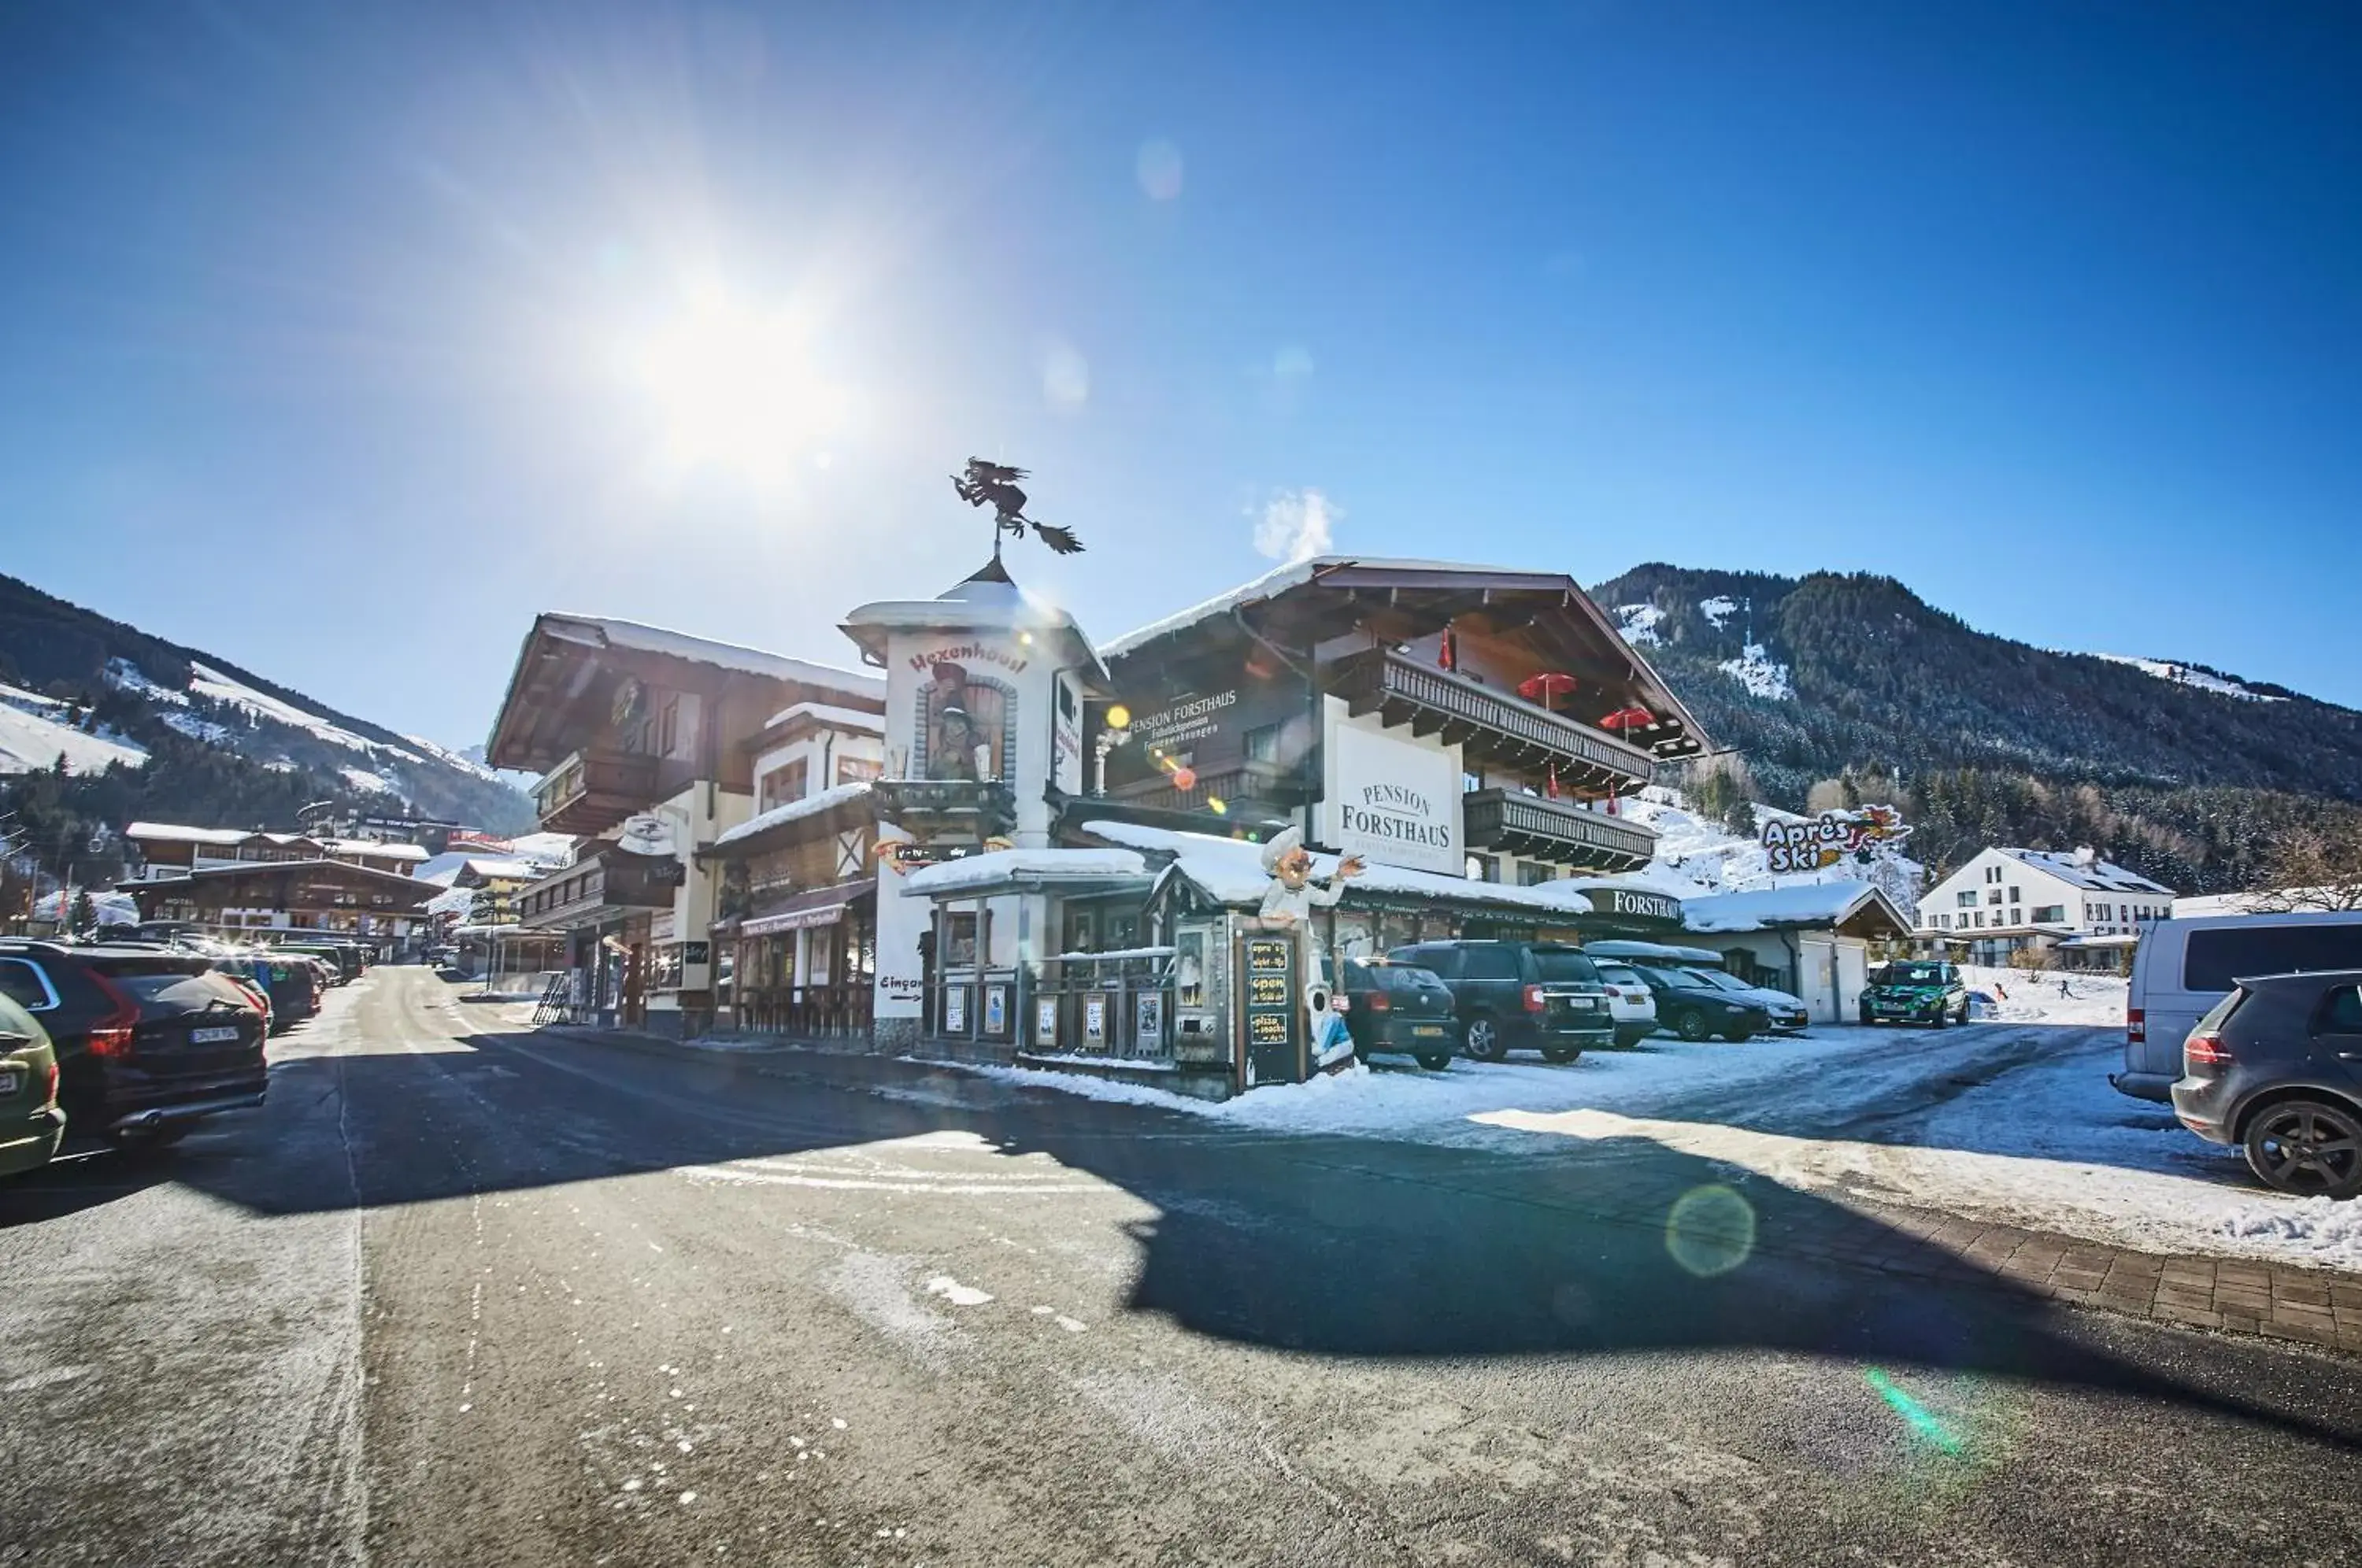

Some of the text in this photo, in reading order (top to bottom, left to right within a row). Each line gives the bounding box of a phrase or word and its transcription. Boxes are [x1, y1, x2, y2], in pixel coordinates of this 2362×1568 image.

[1128, 690, 1236, 734] PENSION FORSTHAUS
[1363, 784, 1431, 817] PENSION
[1342, 804, 1449, 848] FORSTHAUS
[1772, 844, 1819, 871] Ski
[1612, 890, 1679, 920] FORSTHAU
